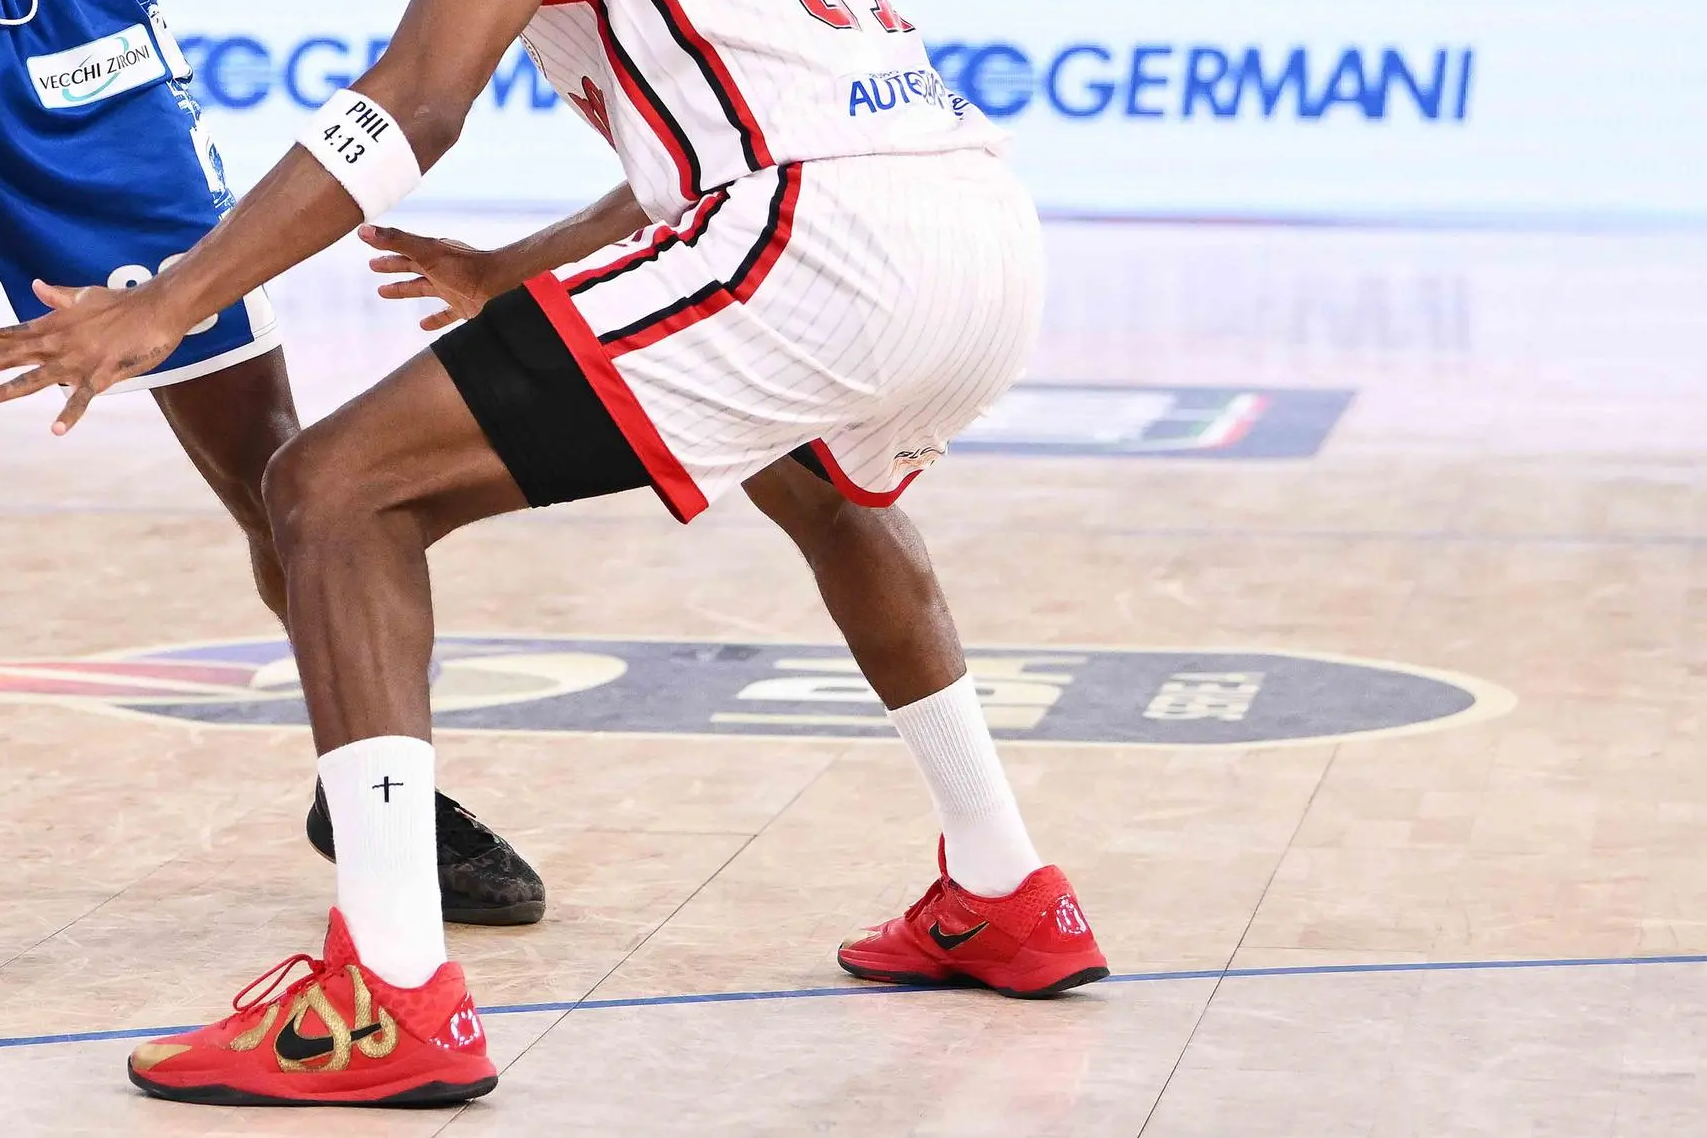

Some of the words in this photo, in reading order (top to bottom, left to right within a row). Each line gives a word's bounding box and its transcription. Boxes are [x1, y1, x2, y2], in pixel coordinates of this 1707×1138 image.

[39, 62, 101, 90] VECCHI
[107, 45, 150, 75] ZIRONI
[1045, 43, 1477, 119] GERMANI
[345, 101, 390, 143] PHIL
[323, 124, 366, 164] 4:13
